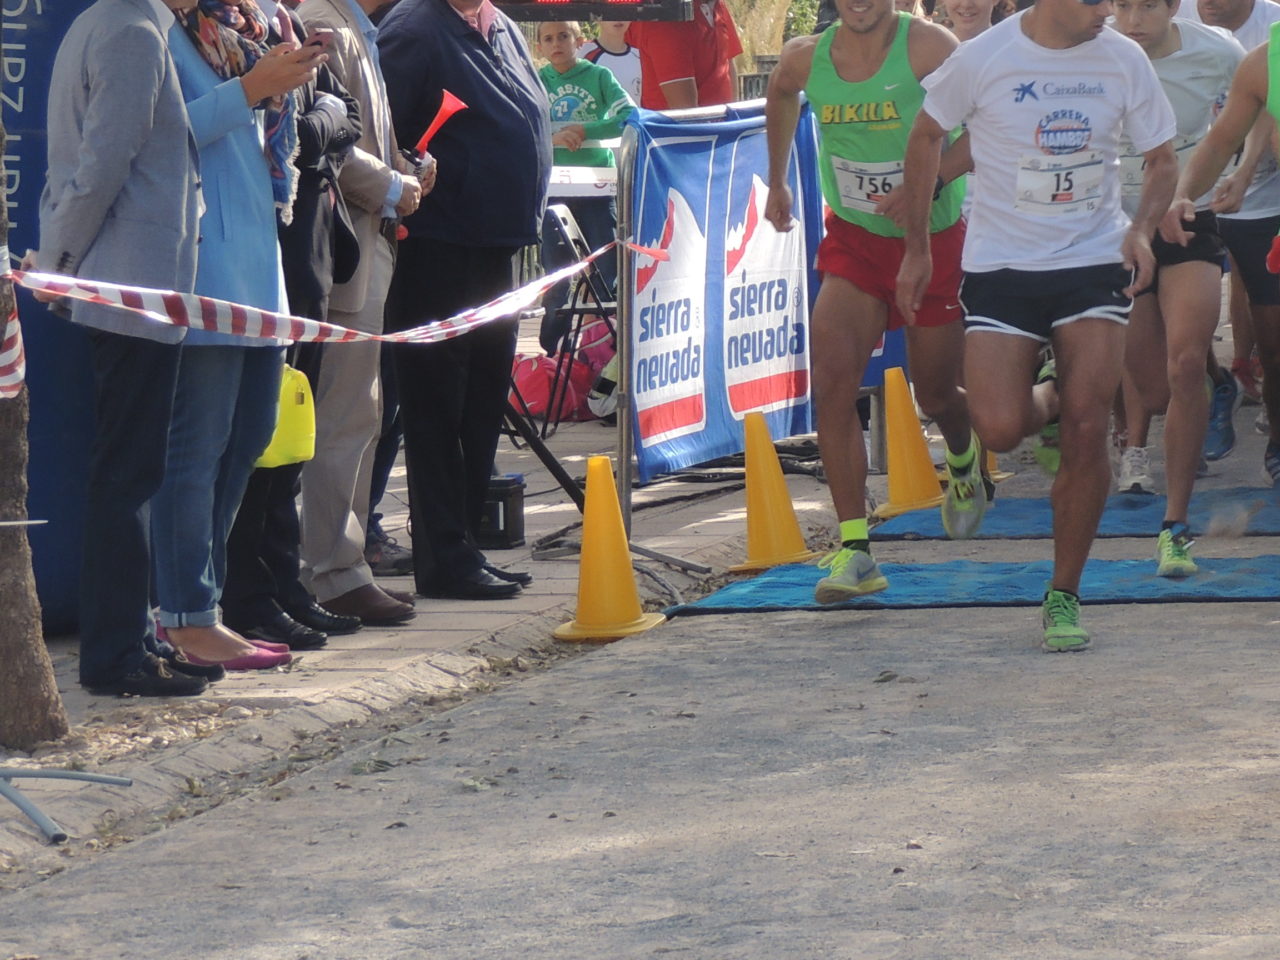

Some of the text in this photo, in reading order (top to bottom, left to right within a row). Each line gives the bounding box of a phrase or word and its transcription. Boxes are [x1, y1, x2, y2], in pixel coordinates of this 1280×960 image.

[548, 83, 596, 107] ARSITY
[1043, 82, 1106, 96] CaixaBank
[555, 100, 568, 117] 77
[822, 100, 902, 125] BIKILA
[1038, 108, 1090, 129] CARRERA
[855, 175, 893, 194] 756
[1054, 171, 1074, 192] 15
[729, 269, 788, 321] sierra
[638, 288, 691, 343] sierra
[728, 315, 806, 370] nevada
[636, 337, 701, 395] nevada
